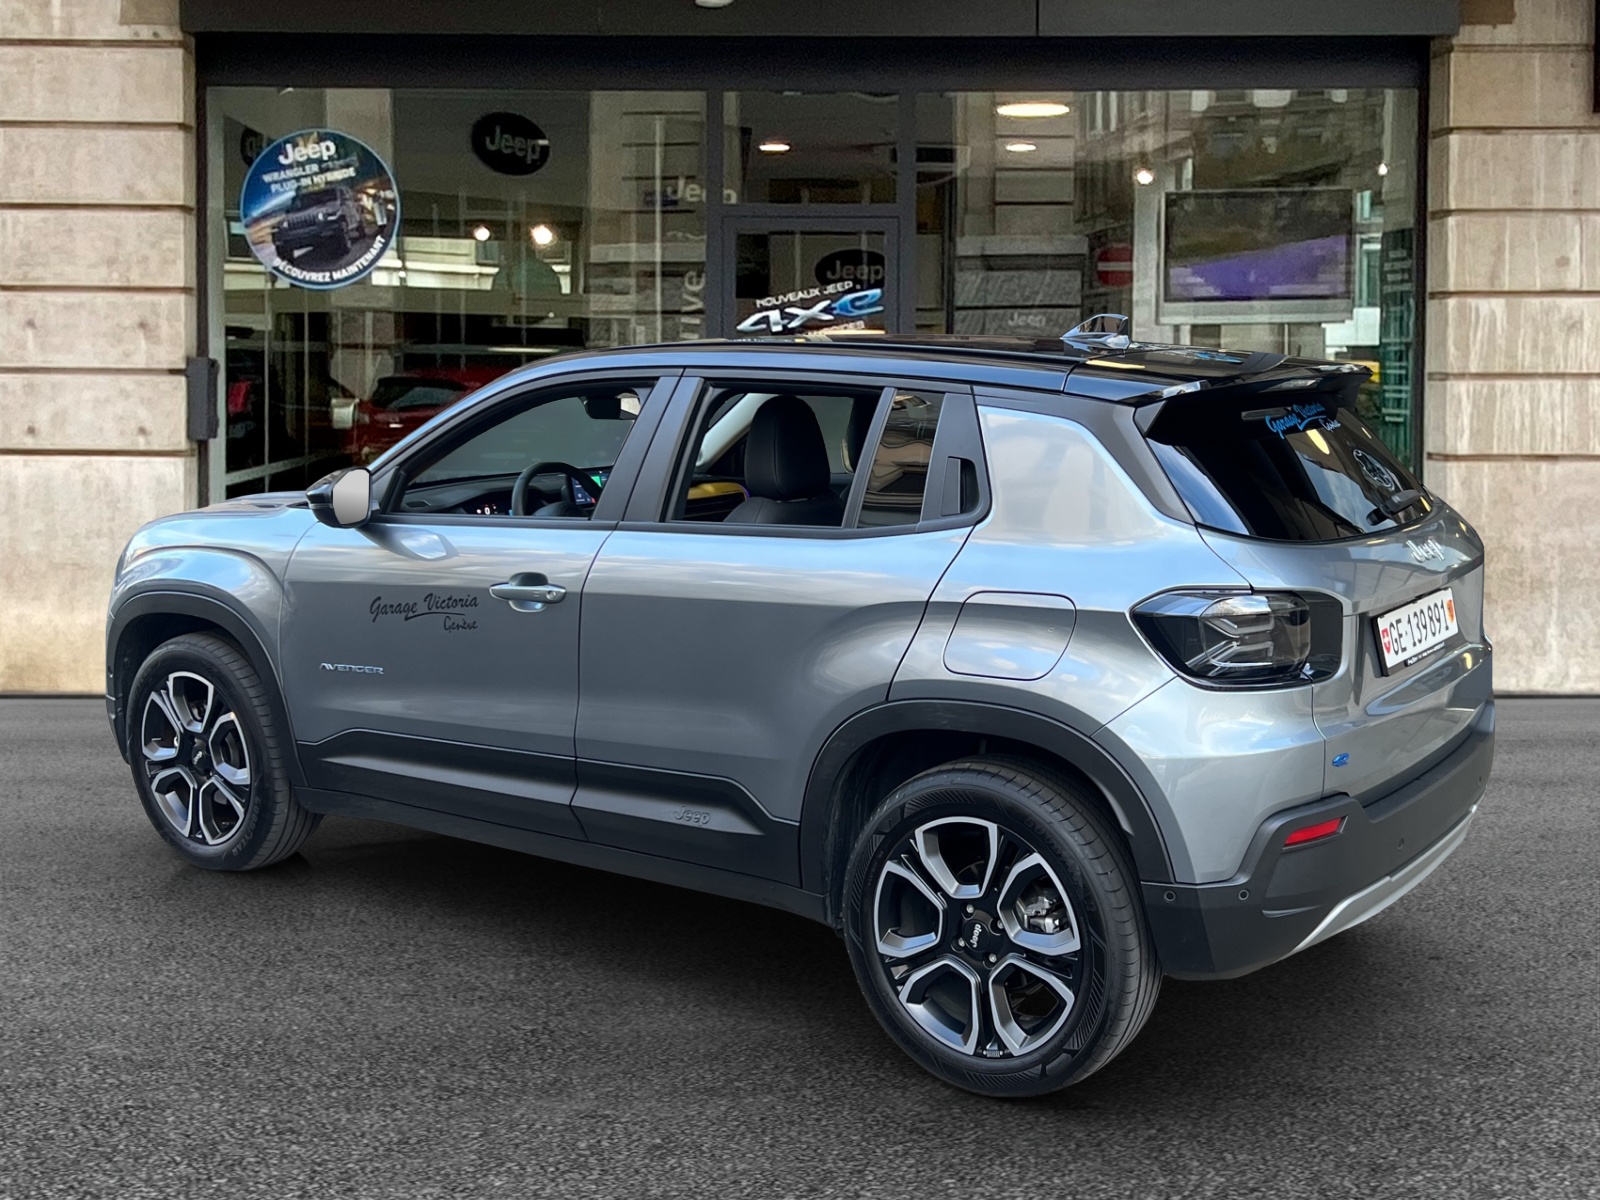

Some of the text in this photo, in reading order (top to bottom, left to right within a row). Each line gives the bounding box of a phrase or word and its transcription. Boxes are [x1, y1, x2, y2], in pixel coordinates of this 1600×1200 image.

[278, 140, 336, 166] Jeep
[485, 125, 541, 164] Jeep
[262, 163, 320, 183] WRANGLER
[270, 175, 312, 193] PLUG-IN
[332, 235, 386, 280] MAINTENANT
[826, 260, 884, 284] Jeep
[756, 280, 853, 309] NOUVEAUX JEEP
[370, 592, 479, 623] Garage Victoria
[443, 615, 478, 633] Genève
[319, 662, 384, 675] AVENGER
[673, 805, 710, 826] Jeep
[970, 923, 982, 948] Jeep
